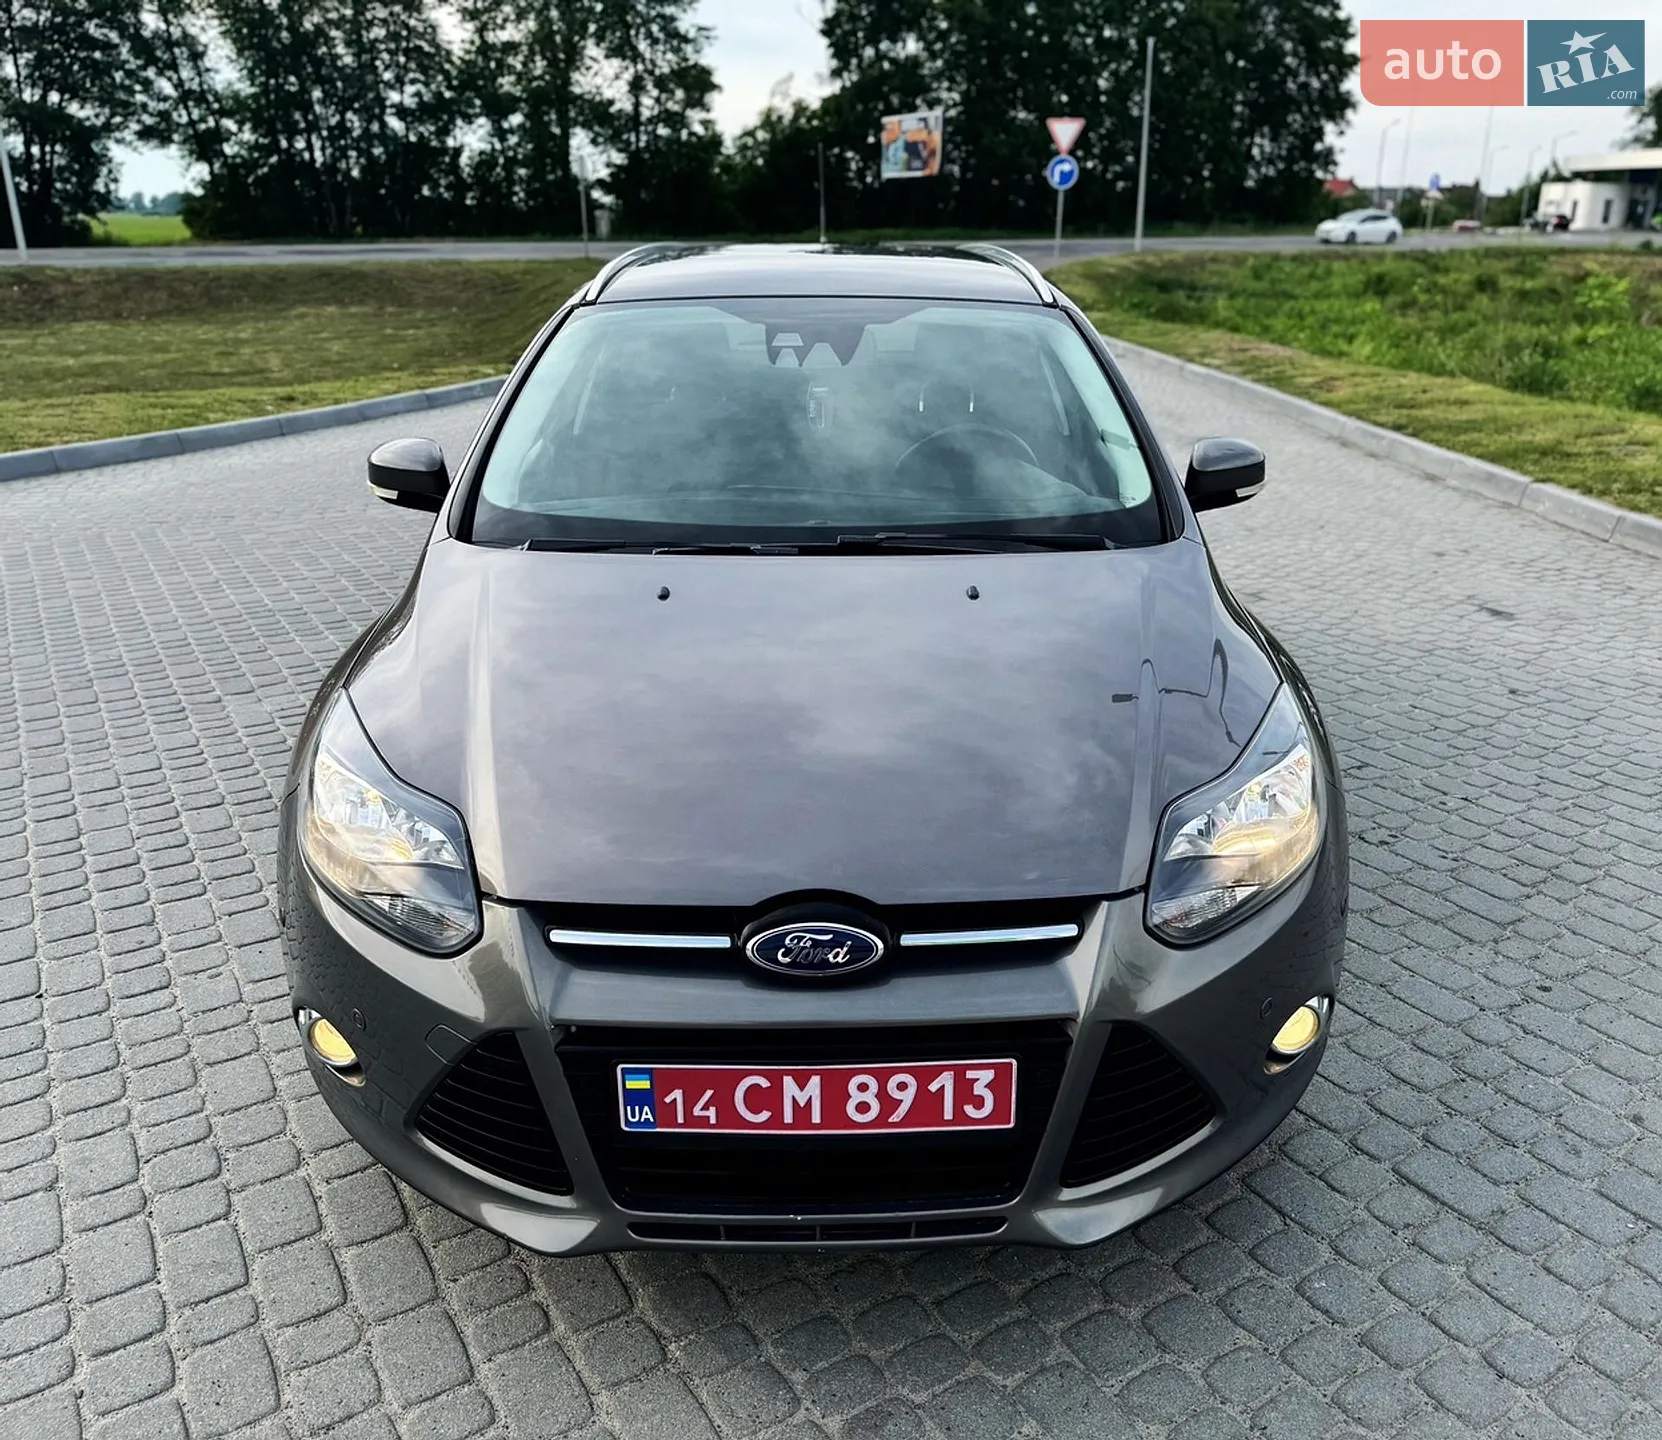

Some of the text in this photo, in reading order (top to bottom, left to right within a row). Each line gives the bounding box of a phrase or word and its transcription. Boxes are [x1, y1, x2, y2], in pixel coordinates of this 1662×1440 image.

[777, 932, 852, 964] Ford
[664, 1069, 995, 1124] 14 CM 8913
[626, 1106, 654, 1122] UA
